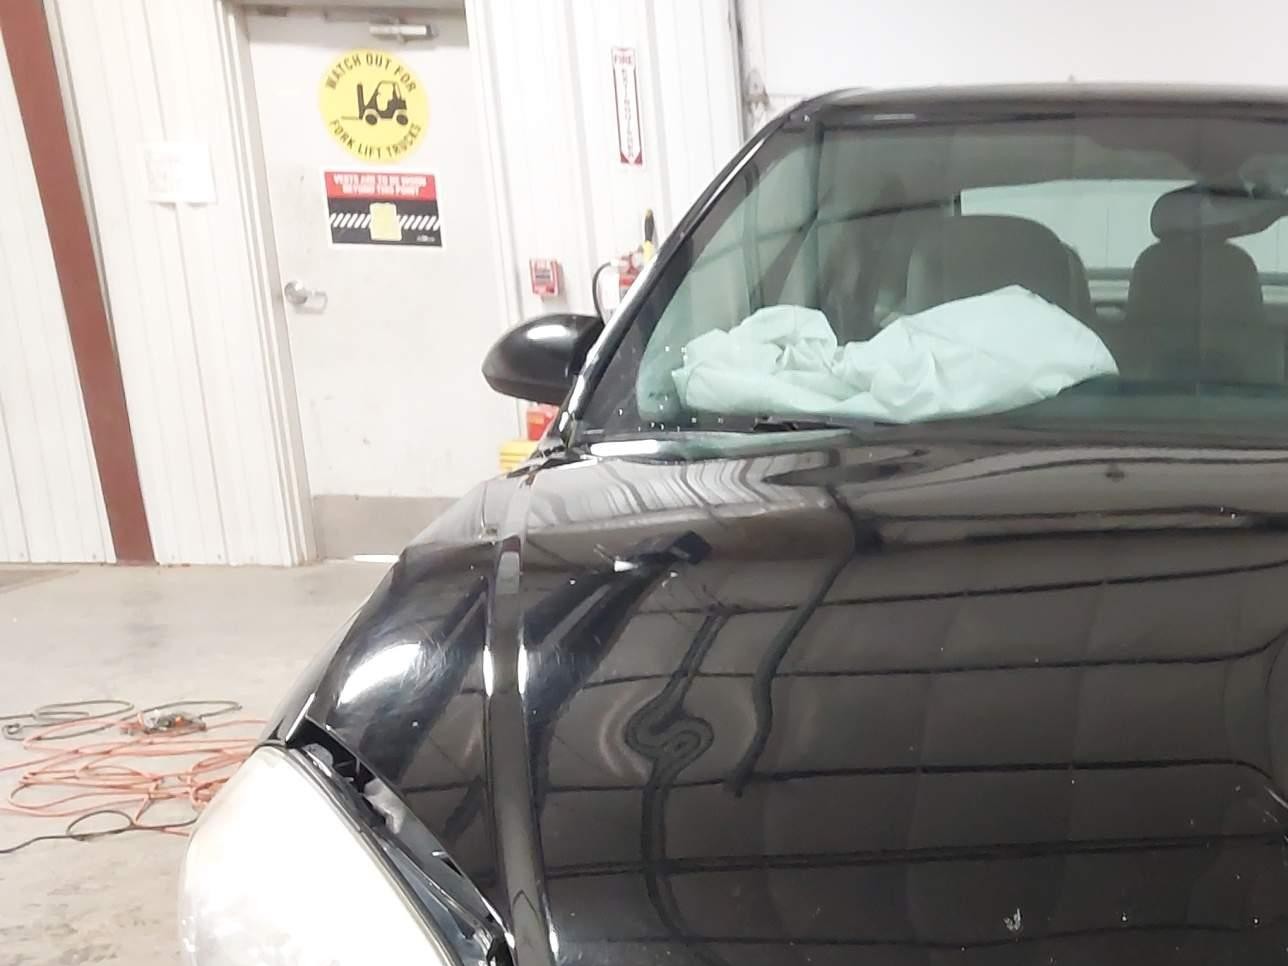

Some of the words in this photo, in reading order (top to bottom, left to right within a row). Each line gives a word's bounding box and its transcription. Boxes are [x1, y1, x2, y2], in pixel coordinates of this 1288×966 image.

[325, 53, 361, 90] WATCH
[366, 53, 392, 70] OUT
[394, 65, 417, 92] FOR
[329, 119, 355, 149] FORK
[357, 143, 382, 160] LIFT
[386, 122, 421, 158] TRUCKS
